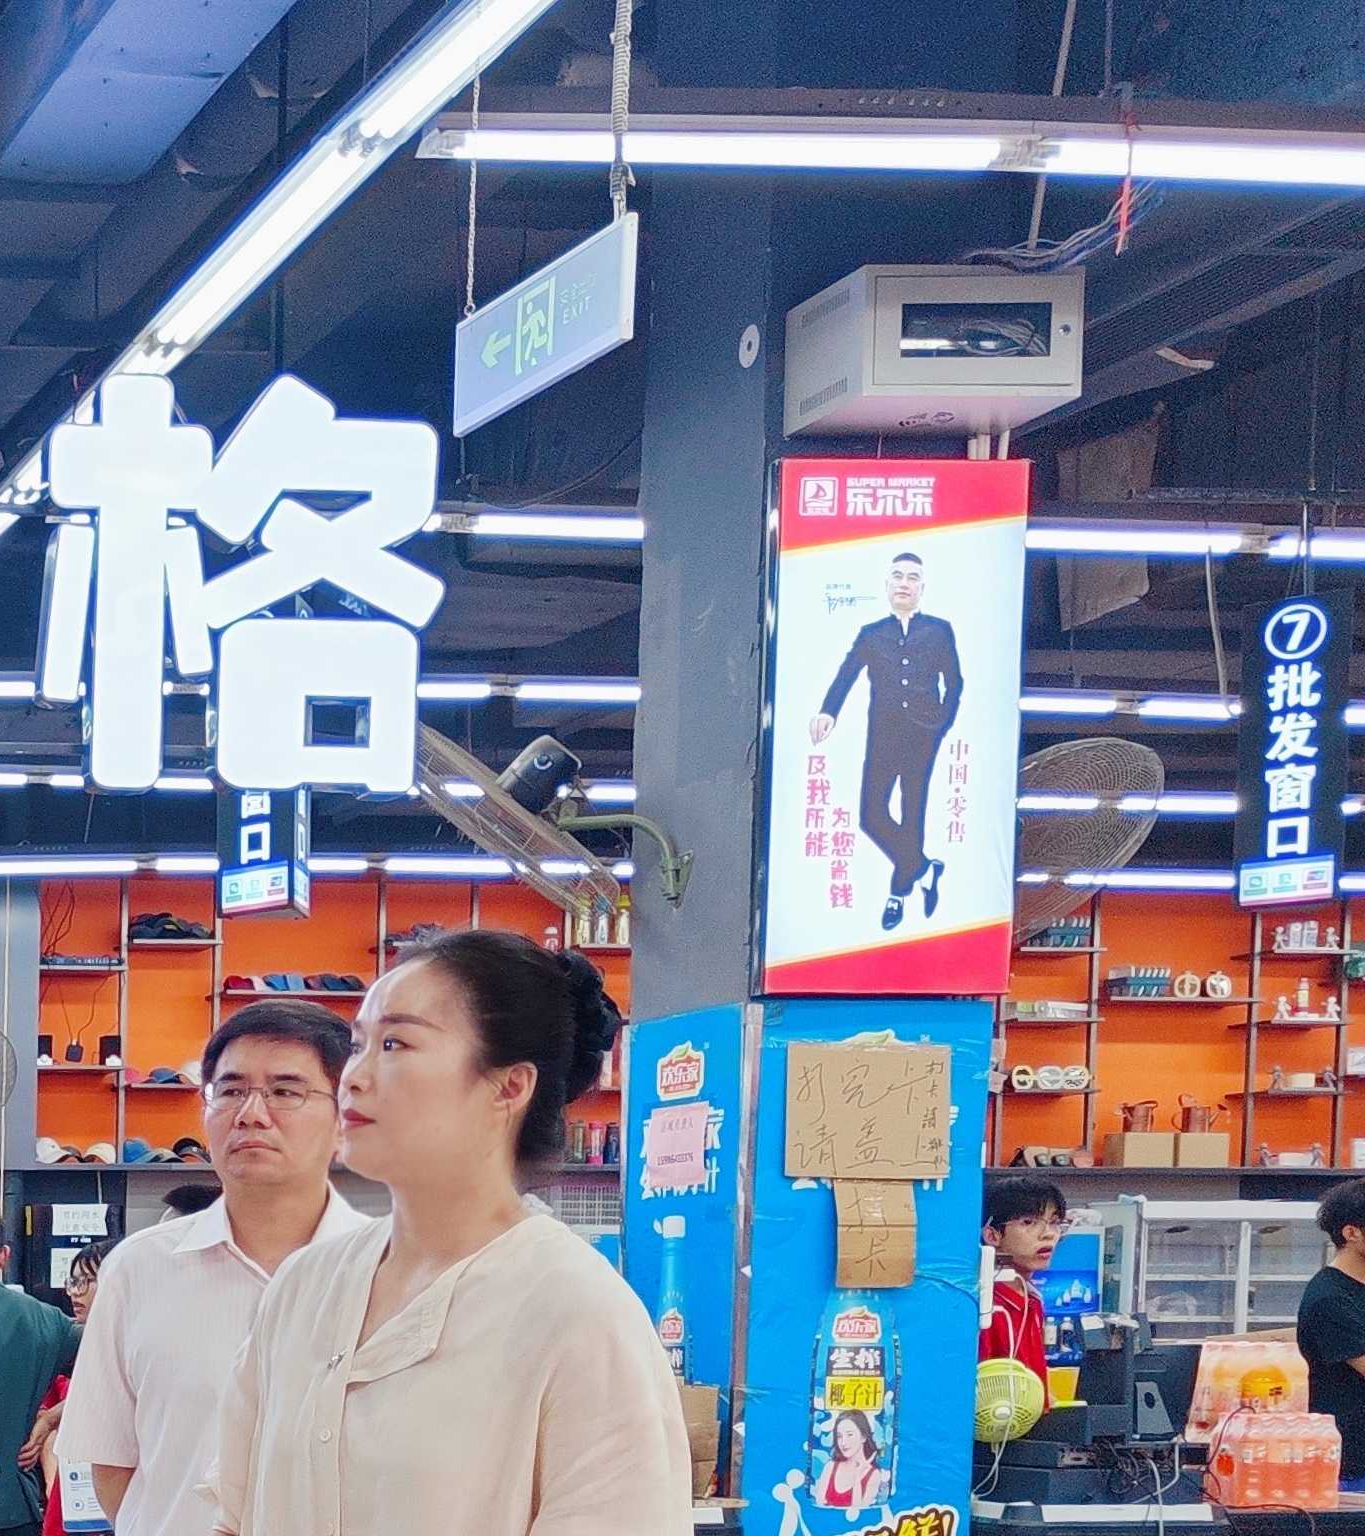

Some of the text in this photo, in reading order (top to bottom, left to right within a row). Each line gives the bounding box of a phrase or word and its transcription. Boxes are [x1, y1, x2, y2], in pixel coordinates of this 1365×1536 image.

[562, 296, 591, 325] EXIT
[846, 476, 936, 488] SUPER MARKET
[845, 488, 934, 517] 乐尔乐
[830, 808, 855, 908] 为您省钱
[829, 1381, 882, 1408] 椰子汁
